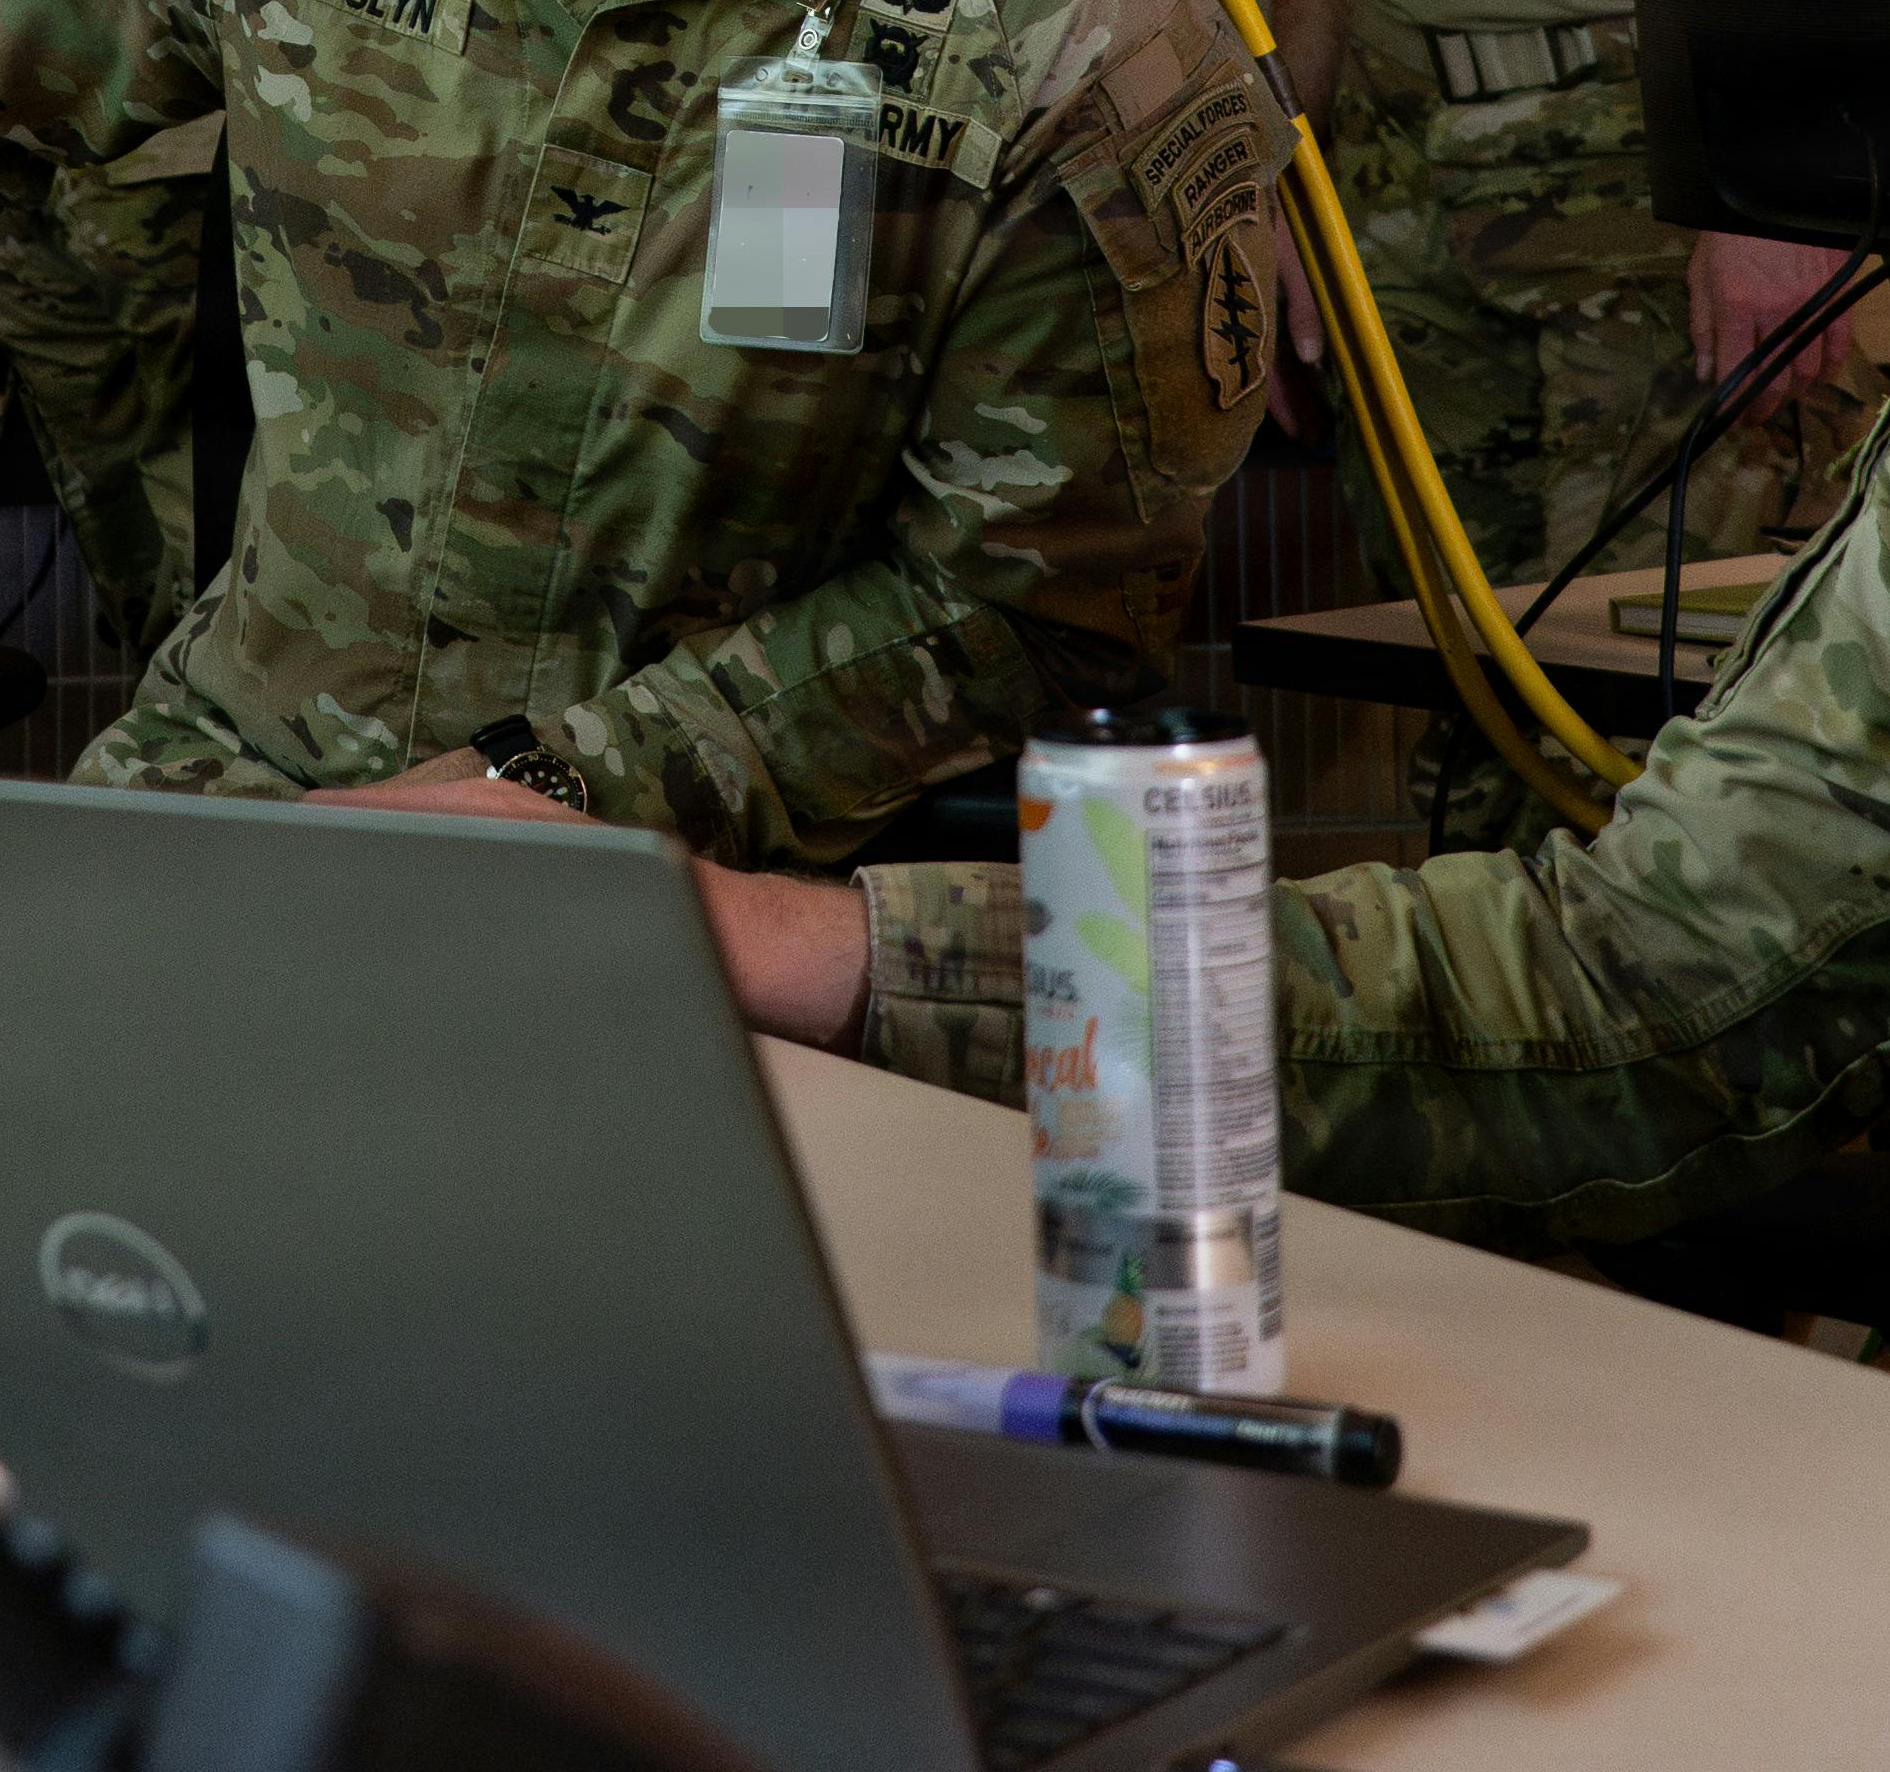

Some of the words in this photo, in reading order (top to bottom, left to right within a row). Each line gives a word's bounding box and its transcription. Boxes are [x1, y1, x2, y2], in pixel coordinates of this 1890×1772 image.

[1144, 120, 1205, 187] SPECIAL
[1196, 93, 1248, 130] FORCES
[1183, 140, 1249, 209] RANGER
[1191, 188, 1257, 256] AIRBORNE
